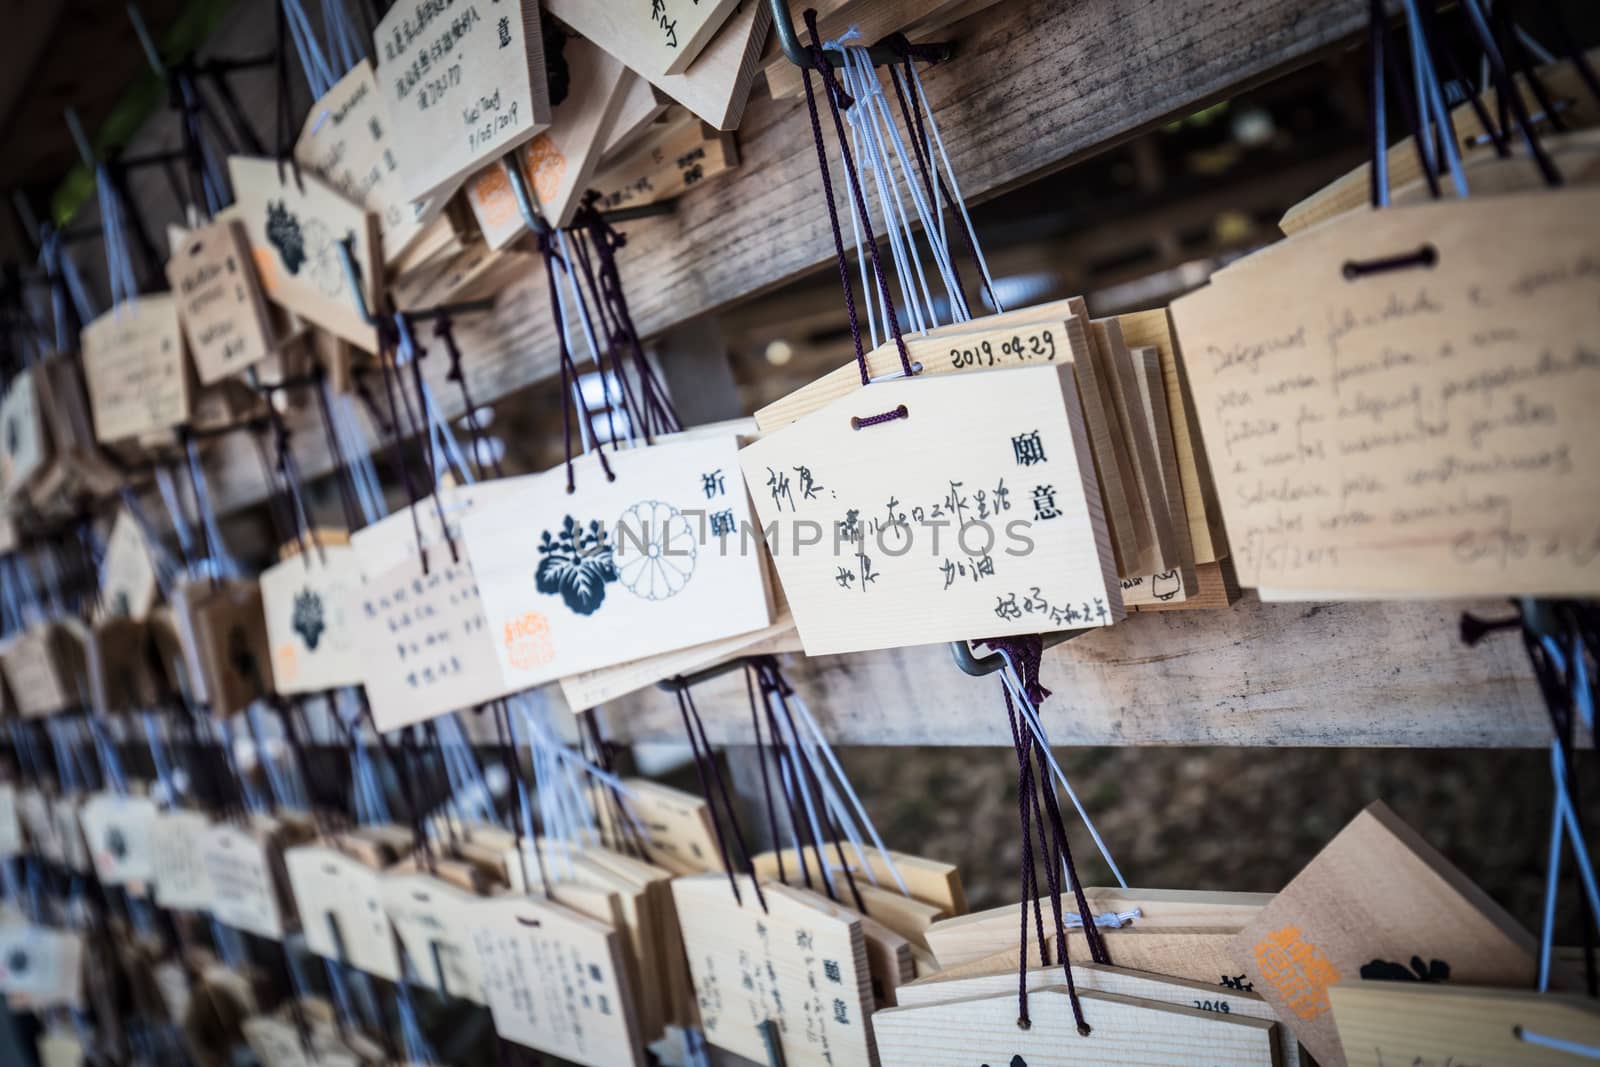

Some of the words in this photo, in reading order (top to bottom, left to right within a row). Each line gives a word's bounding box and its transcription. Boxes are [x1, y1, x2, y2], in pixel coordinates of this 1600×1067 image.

[950, 330, 1056, 369] 2019.04.29
[701, 469, 738, 537] 祈願
[1011, 430, 1063, 522] 願意
[938, 546, 995, 590] 加油
